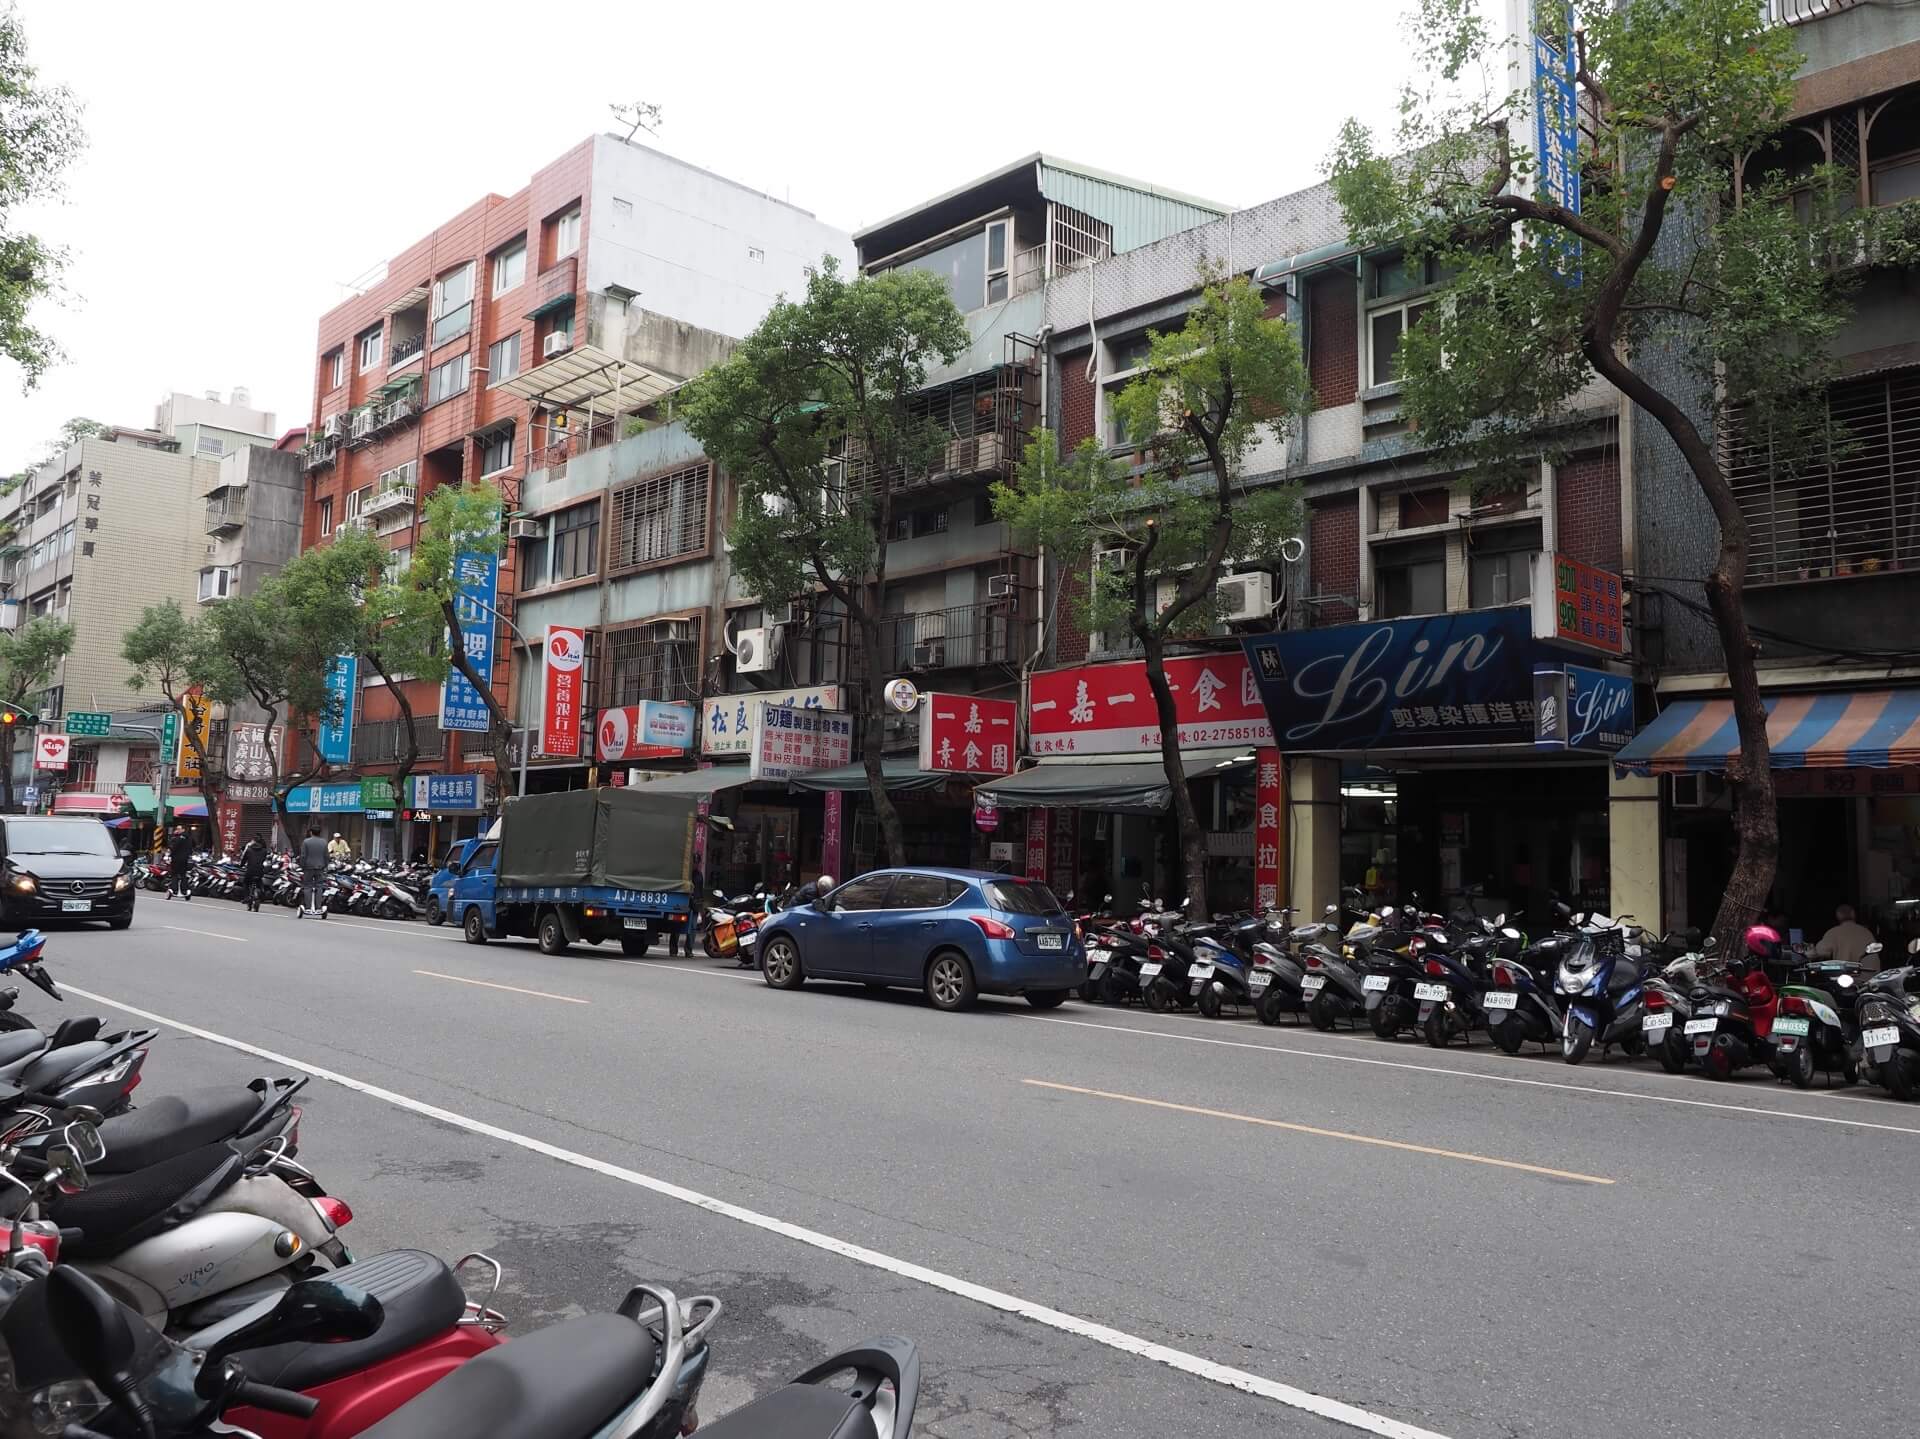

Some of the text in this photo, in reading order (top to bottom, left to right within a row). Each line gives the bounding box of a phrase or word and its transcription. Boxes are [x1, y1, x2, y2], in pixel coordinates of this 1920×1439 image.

[331, 661, 348, 742] 台北行
[1032, 667, 1264, 725] 一嘉一食園
[1286, 626, 1503, 740] Lin
[1570, 678, 1631, 745] Lin
[936, 702, 1009, 734] 一嘉一
[937, 737, 1008, 773] 素食園
[1258, 763, 1279, 908] 素食拉麵
[614, 889, 668, 905] AJJ-8833
